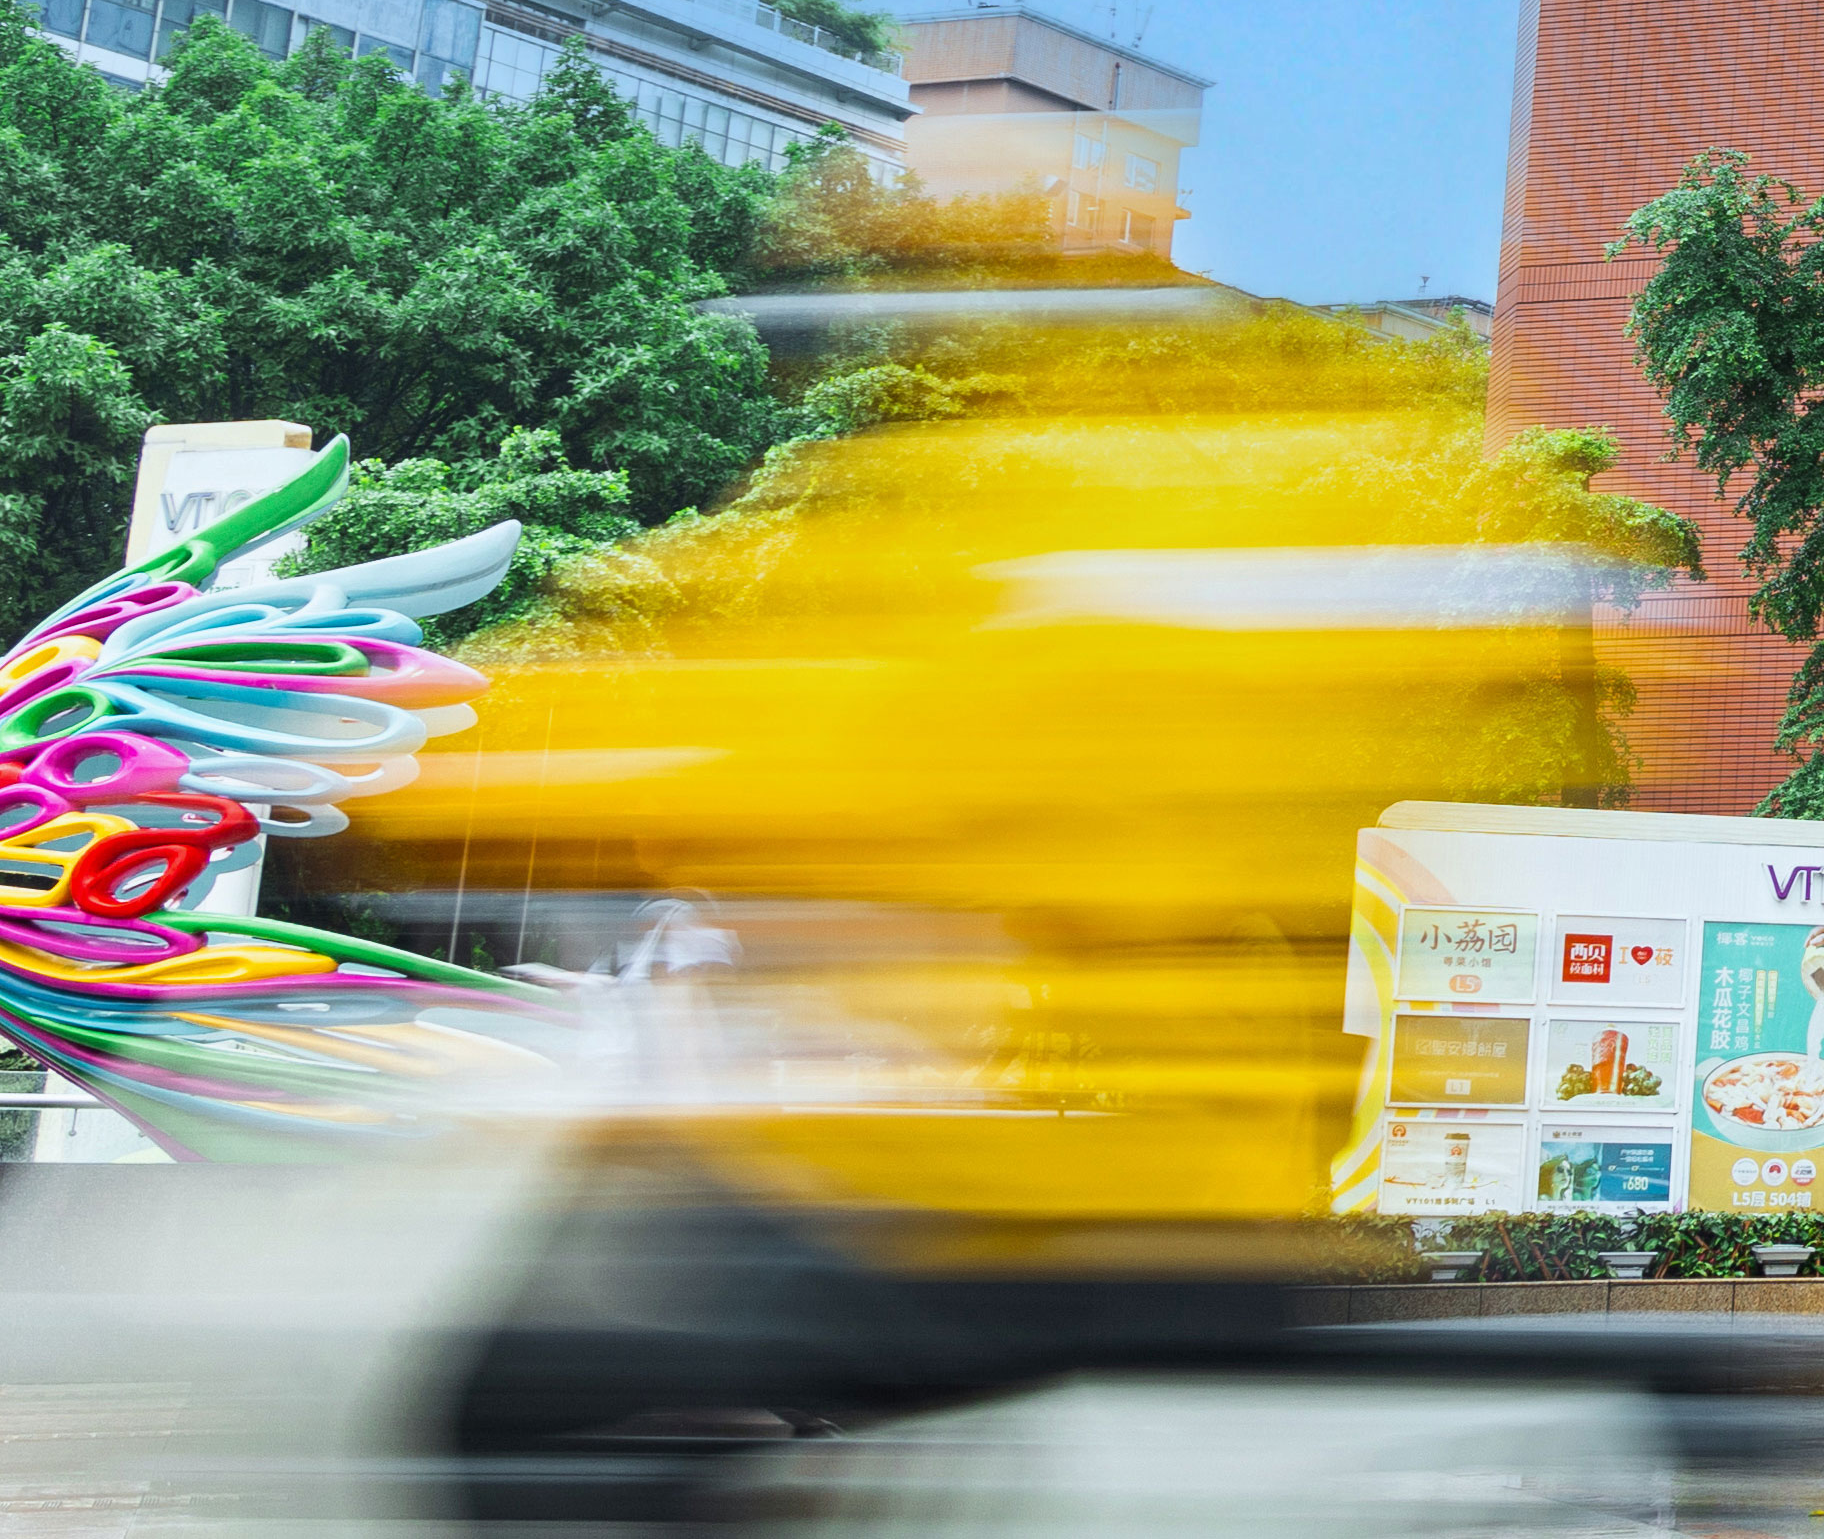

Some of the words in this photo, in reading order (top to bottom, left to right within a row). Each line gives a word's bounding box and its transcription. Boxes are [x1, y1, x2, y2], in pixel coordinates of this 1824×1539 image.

[1420, 919, 1518, 954] 小荔园
[1570, 943, 1606, 961] 西贝
[1456, 976, 1475, 992] L5
[1710, 966, 1735, 1050] 木瓜花胶
[1734, 968, 1753, 1051] 椰子文昌鸡
[1732, 1191, 1767, 1207] L5层
